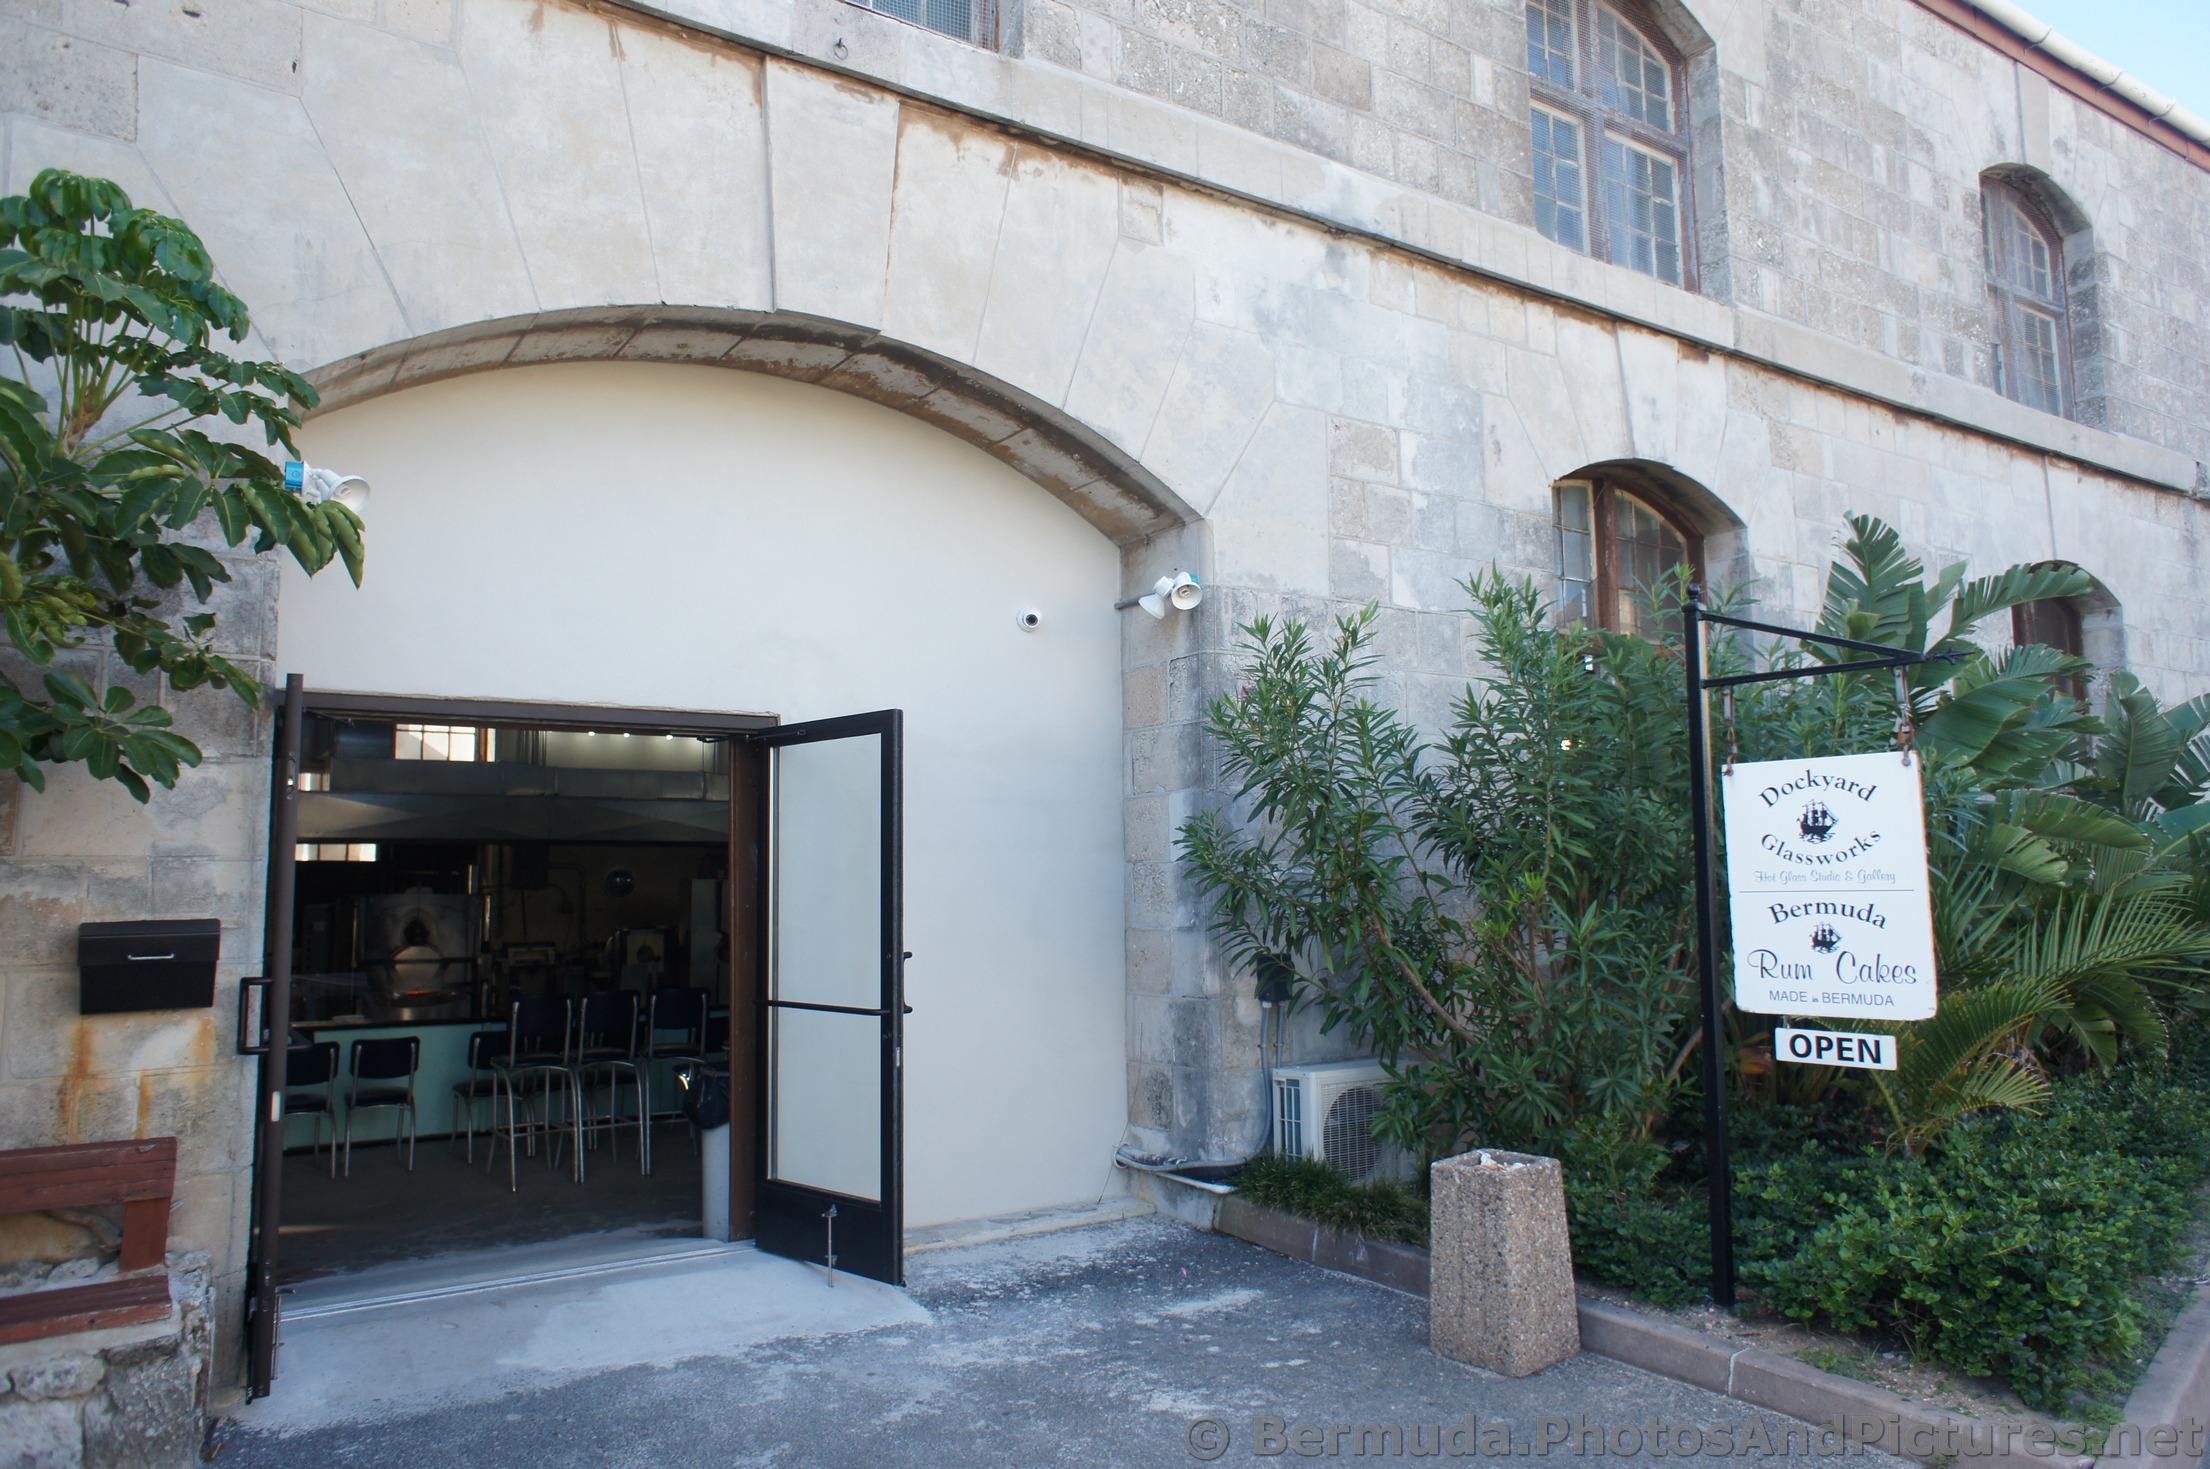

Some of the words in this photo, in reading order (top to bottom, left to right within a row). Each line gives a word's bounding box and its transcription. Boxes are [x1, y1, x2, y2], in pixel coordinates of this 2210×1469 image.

[1758, 769, 1877, 808] Dockyard
[1761, 830, 1881, 865] Glassworks
[1754, 870, 1778, 884] Hot
[1780, 871, 1807, 882] Glass
[1810, 870, 1841, 882] Studio
[1845, 871, 1853, 881] &
[1857, 870, 1895, 884] Gallery
[1768, 901, 1887, 929] Bermuda
[1747, 949, 1812, 980] Rum
[1836, 951, 1917, 984] Cakes
[1769, 990, 1808, 1003] MADE
[1822, 992, 1894, 1006] BERMUDA
[1789, 1033, 1882, 1064] OPEN
